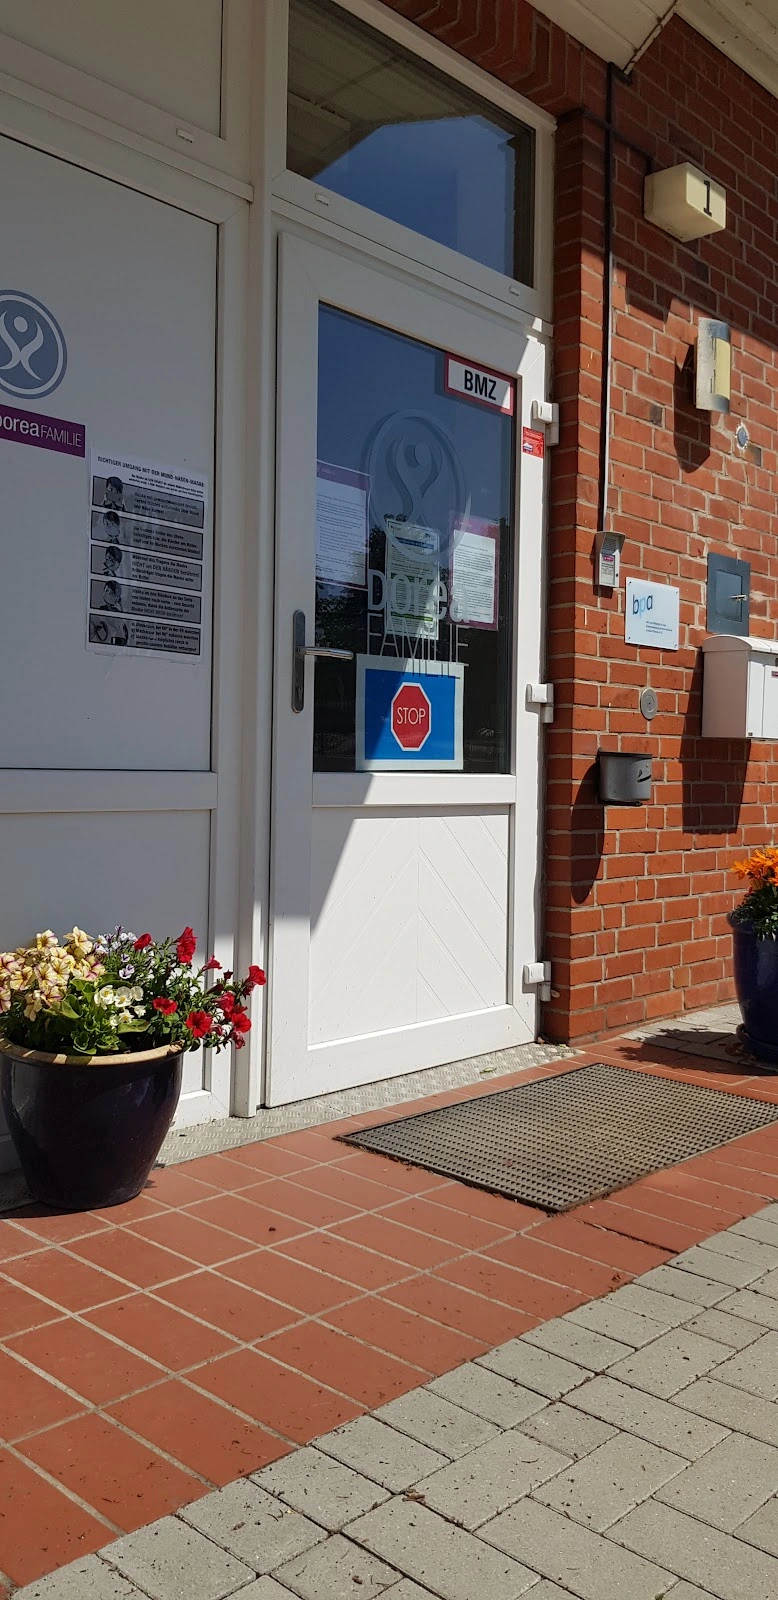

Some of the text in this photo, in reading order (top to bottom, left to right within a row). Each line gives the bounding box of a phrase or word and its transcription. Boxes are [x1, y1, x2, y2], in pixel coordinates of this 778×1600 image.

[704, 180, 712, 216] 1
[464, 369, 496, 401] BMZ
[0, 415, 82, 448] oreaFAMILIE
[122, 462, 141, 472] UMGANG
[632, 594, 653, 618] bpa
[368, 613, 469, 667] FAMILIE
[397, 706, 426, 725] STOP
